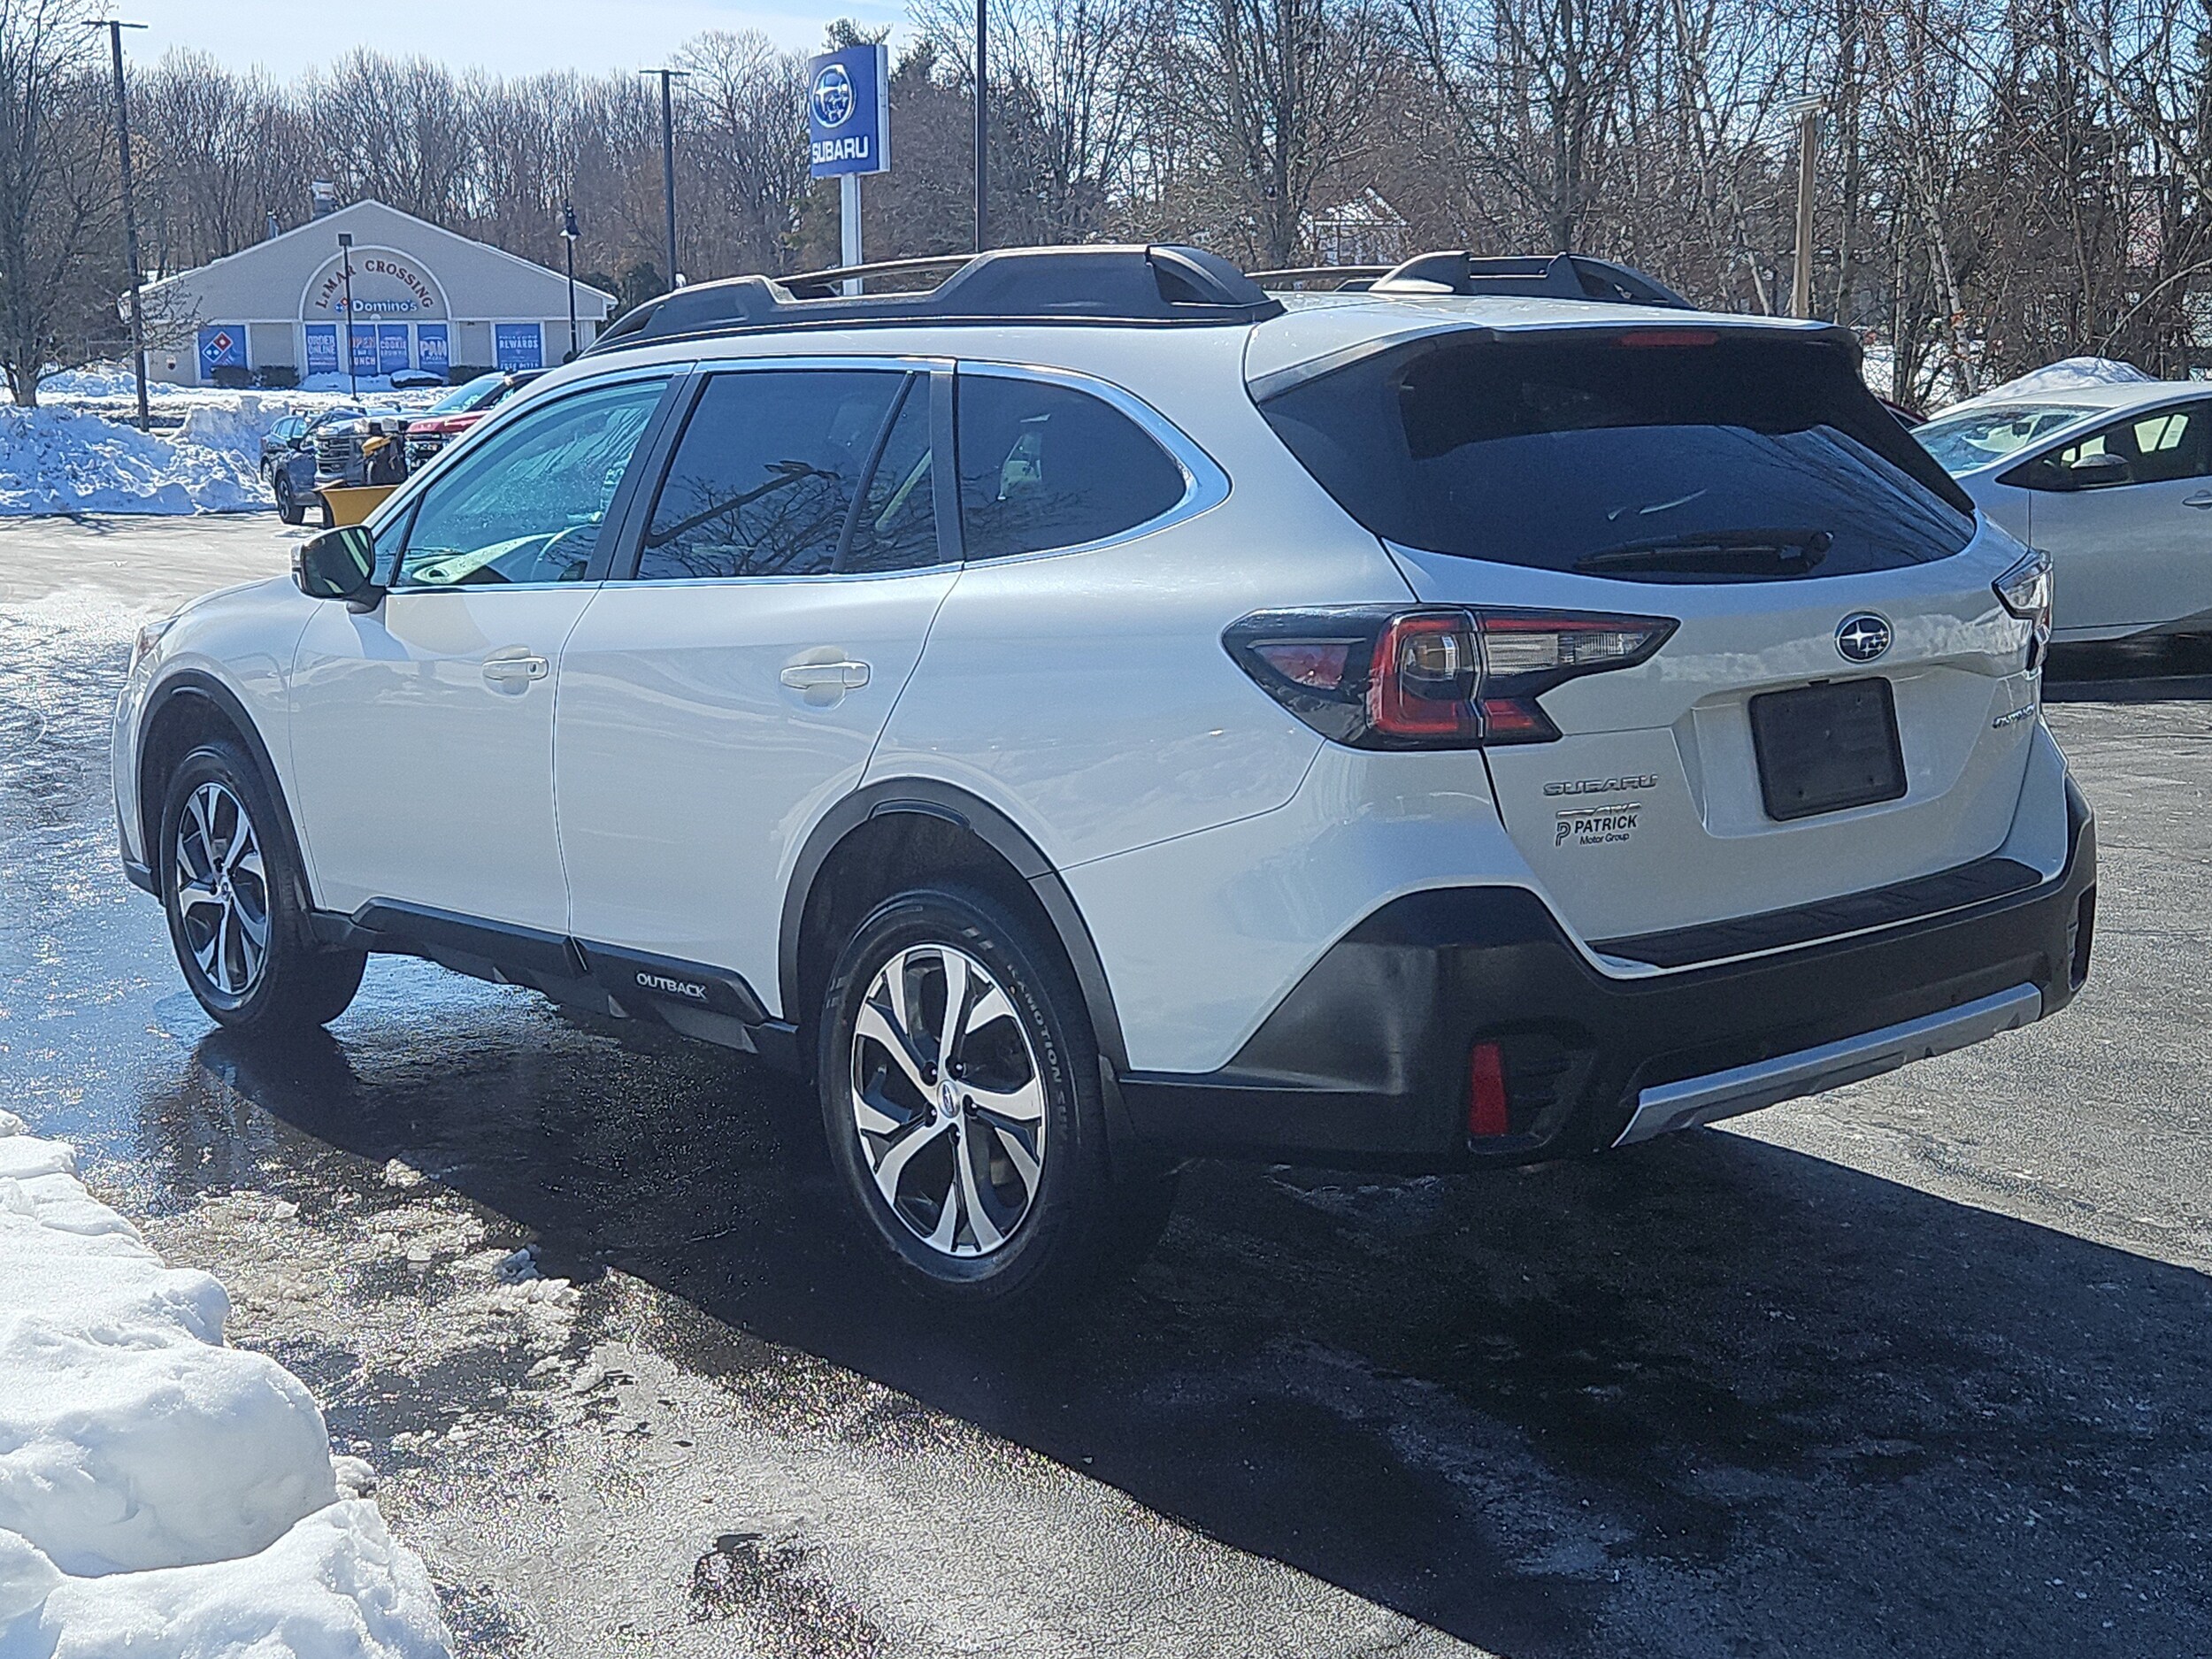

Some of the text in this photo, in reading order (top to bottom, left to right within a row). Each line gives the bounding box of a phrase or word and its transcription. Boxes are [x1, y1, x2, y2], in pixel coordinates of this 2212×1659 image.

[811, 134, 869, 165] SUBARU
[365, 260, 434, 308] CROSSING
[352, 300, 418, 312] Domino's
[307, 335, 335, 345] ORDER
[349, 336, 375, 349] PEN
[380, 341, 407, 349] COOKIE
[499, 339, 538, 349] REWARDS
[307, 345, 336, 355] ONLINE
[419, 340, 448, 357] PAN
[1542, 772, 1659, 797] SUBARU
[1574, 814, 1639, 833] PATRICK
[1579, 833, 1630, 845] Motor Group
[635, 972, 708, 1001] OUTBACK
